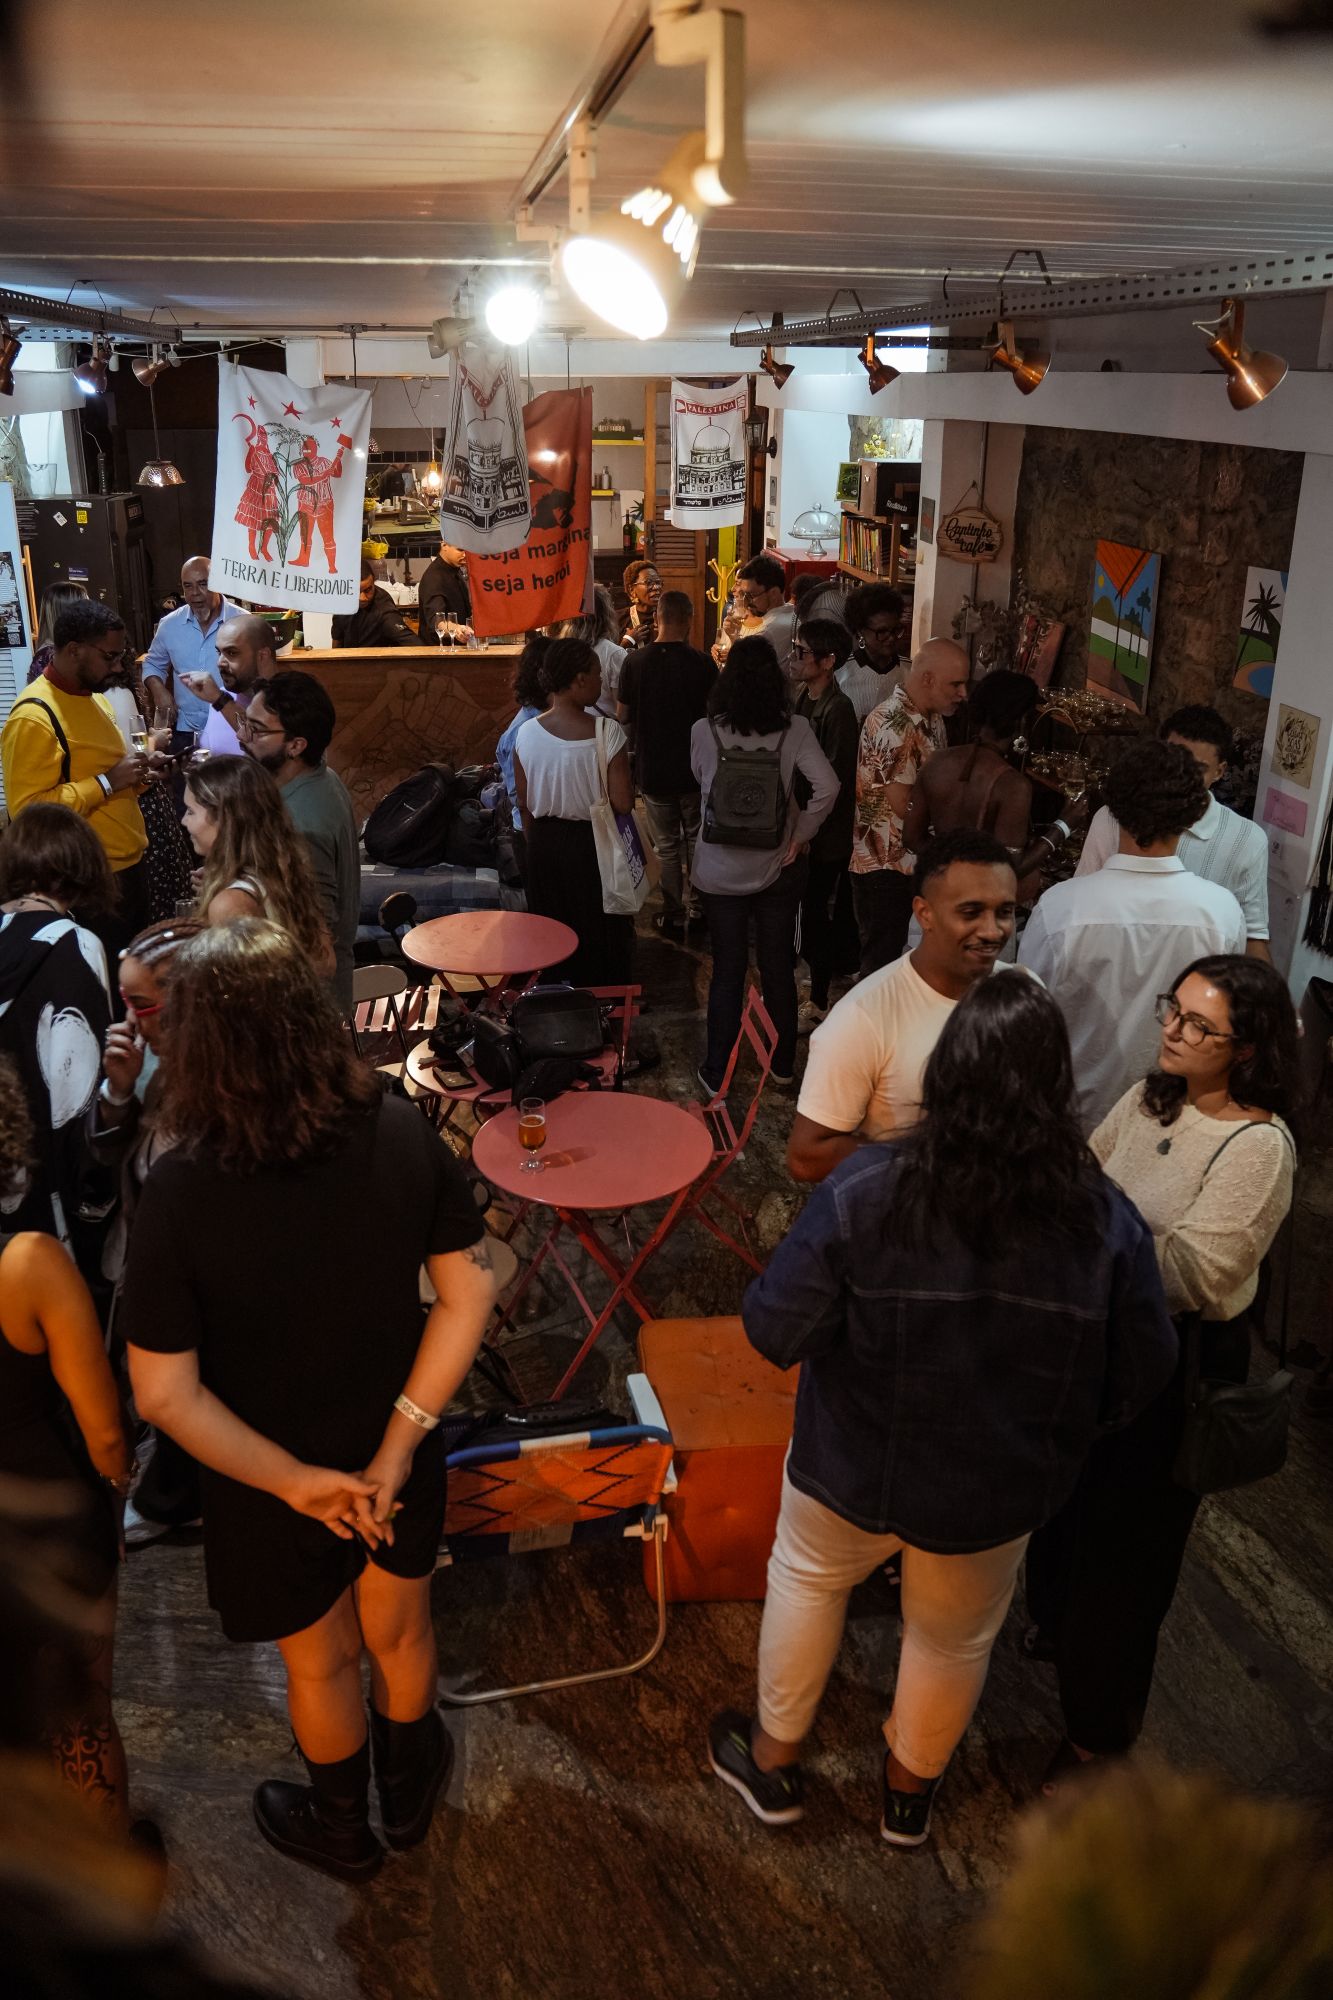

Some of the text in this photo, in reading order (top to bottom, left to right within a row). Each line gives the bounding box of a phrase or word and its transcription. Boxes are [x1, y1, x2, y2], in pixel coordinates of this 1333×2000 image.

[688, 401, 734, 413] PALESTINA
[945, 517, 993, 541] Cantinho
[528, 527, 590, 559] margina
[221, 558, 354, 596] TERRA E LIBERDADE
[482, 574, 525, 596] seja
